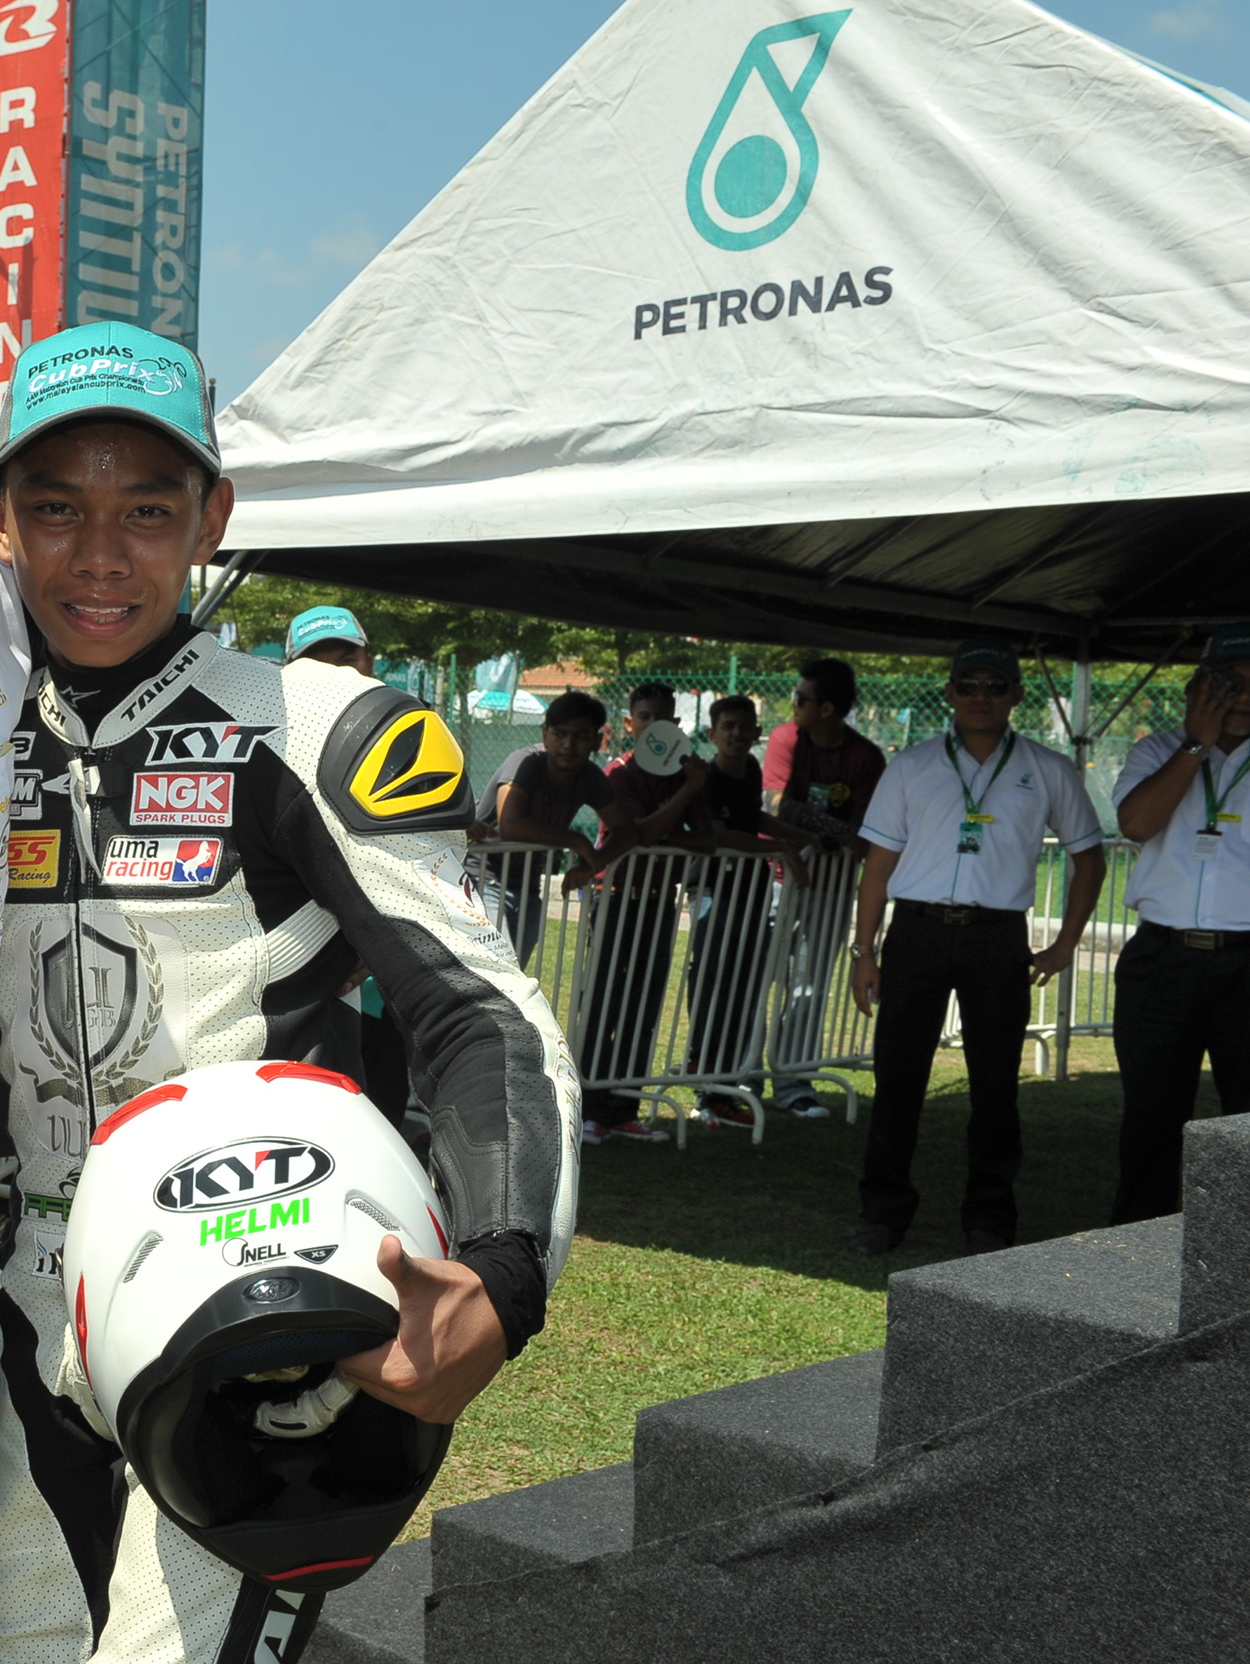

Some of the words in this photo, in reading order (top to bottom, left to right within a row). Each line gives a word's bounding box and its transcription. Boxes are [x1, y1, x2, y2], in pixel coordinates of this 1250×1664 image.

[634, 266, 894, 340] PETRONAS
[29, 346, 133, 378] PETRONAS
[29, 359, 155, 393] CubPrix
[121, 649, 200, 722] TAICHI
[151, 726, 281, 760] KYT
[139, 777, 225, 810] NGK
[135, 813, 176, 824] SPARK
[181, 814, 226, 825] PLUGS
[110, 840, 159, 859] uma
[106, 859, 173, 880] racing
[171, 1146, 309, 1209] KYT
[200, 1197, 310, 1247] HELMI
[230, 1241, 286, 1267] SNELL
